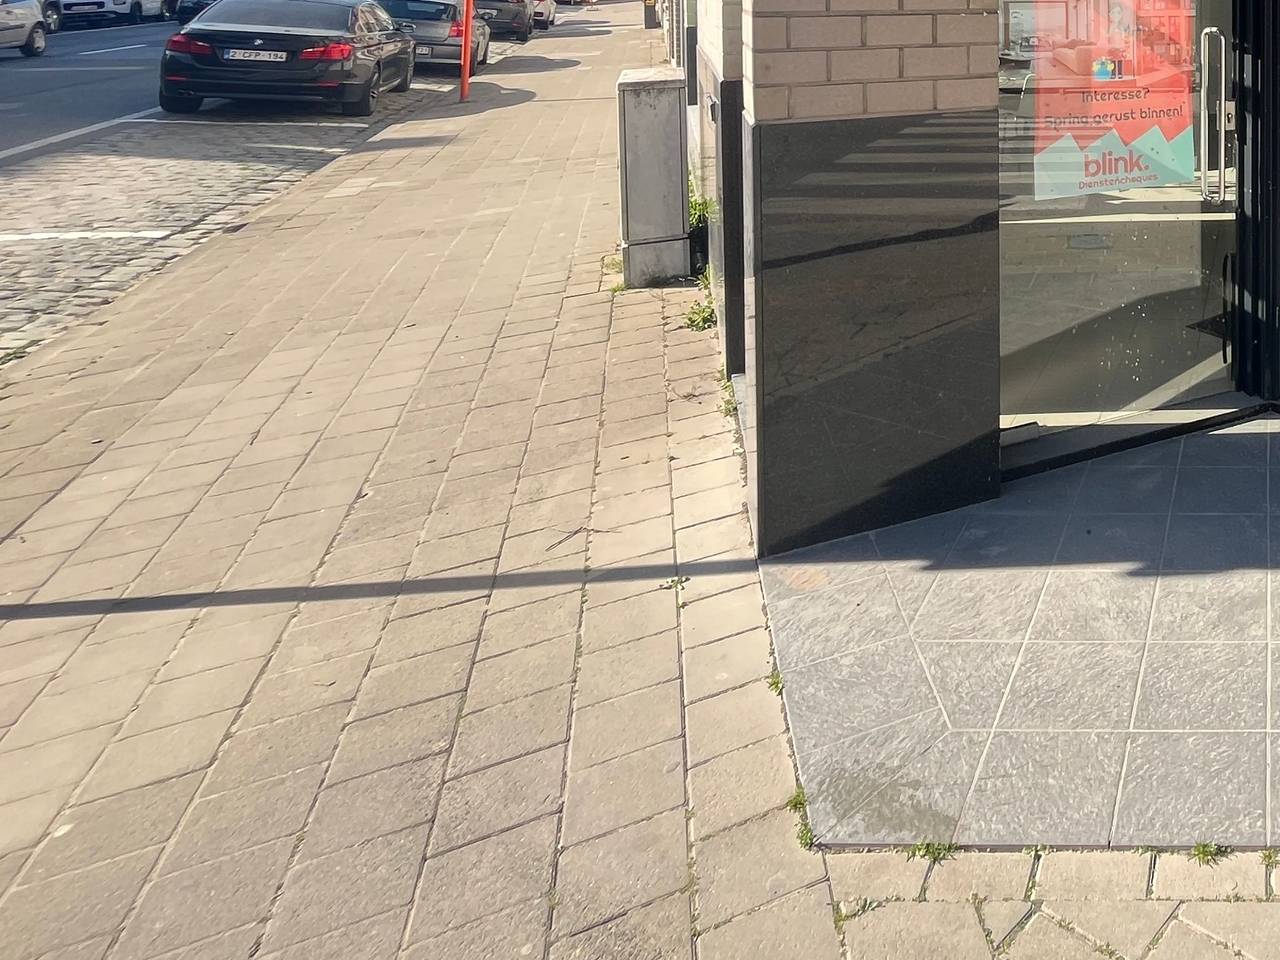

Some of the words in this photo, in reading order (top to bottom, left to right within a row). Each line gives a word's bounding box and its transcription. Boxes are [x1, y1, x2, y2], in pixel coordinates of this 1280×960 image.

[1081, 87, 1150, 103] Interesse?
[1043, 113, 1089, 131] Spring
[1091, 109, 1137, 125] gerust
[1140, 105, 1183, 120] binnen!
[1078, 173, 1159, 190] Dienstencheques
